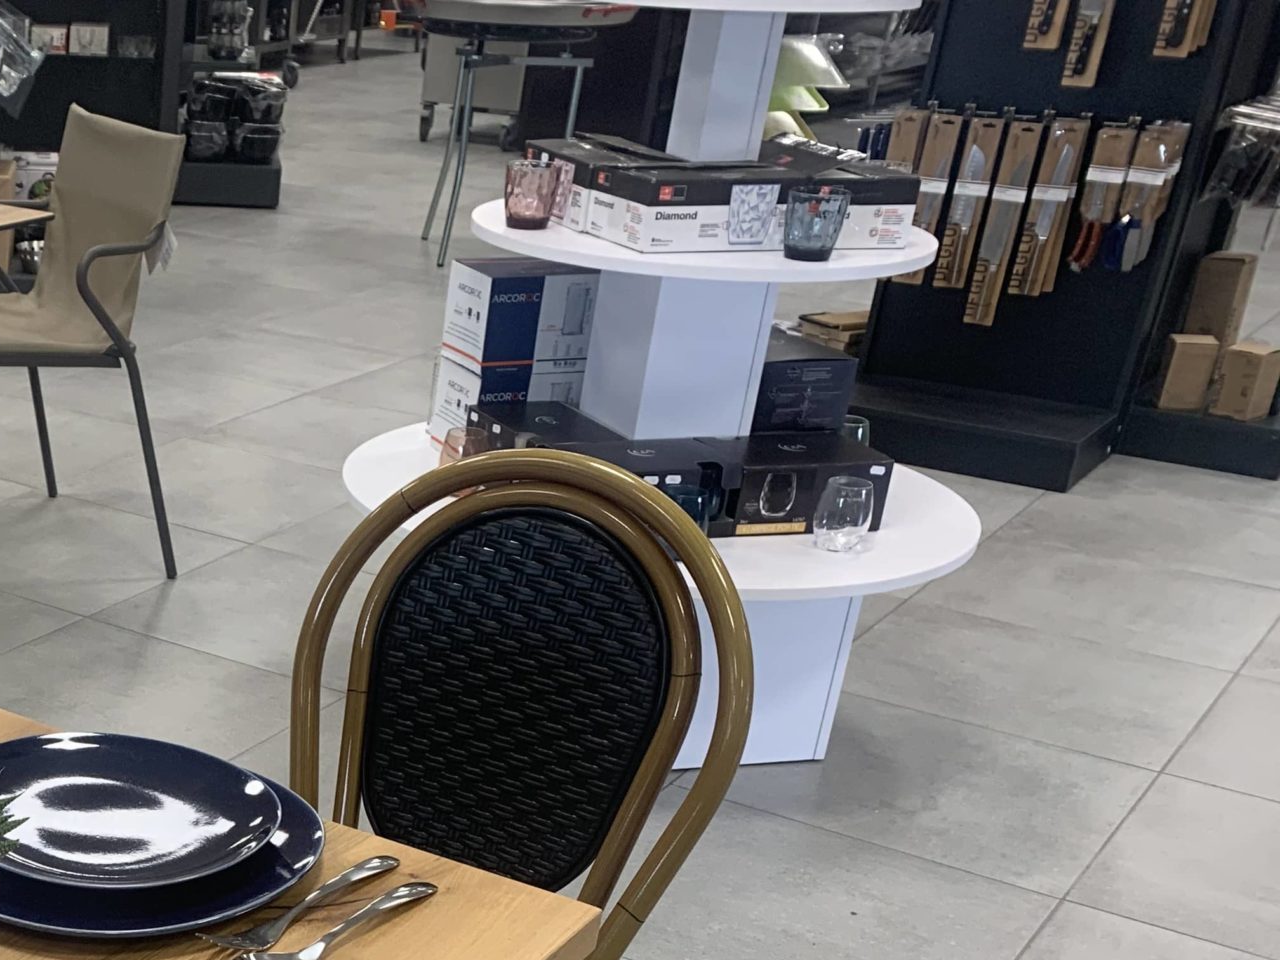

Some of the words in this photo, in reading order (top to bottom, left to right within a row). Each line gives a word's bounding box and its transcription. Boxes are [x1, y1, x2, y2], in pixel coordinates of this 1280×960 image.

[654, 211, 698, 221] Diamond
[491, 292, 541, 304] ARCOROC
[480, 391, 527, 402] ARCOROC
